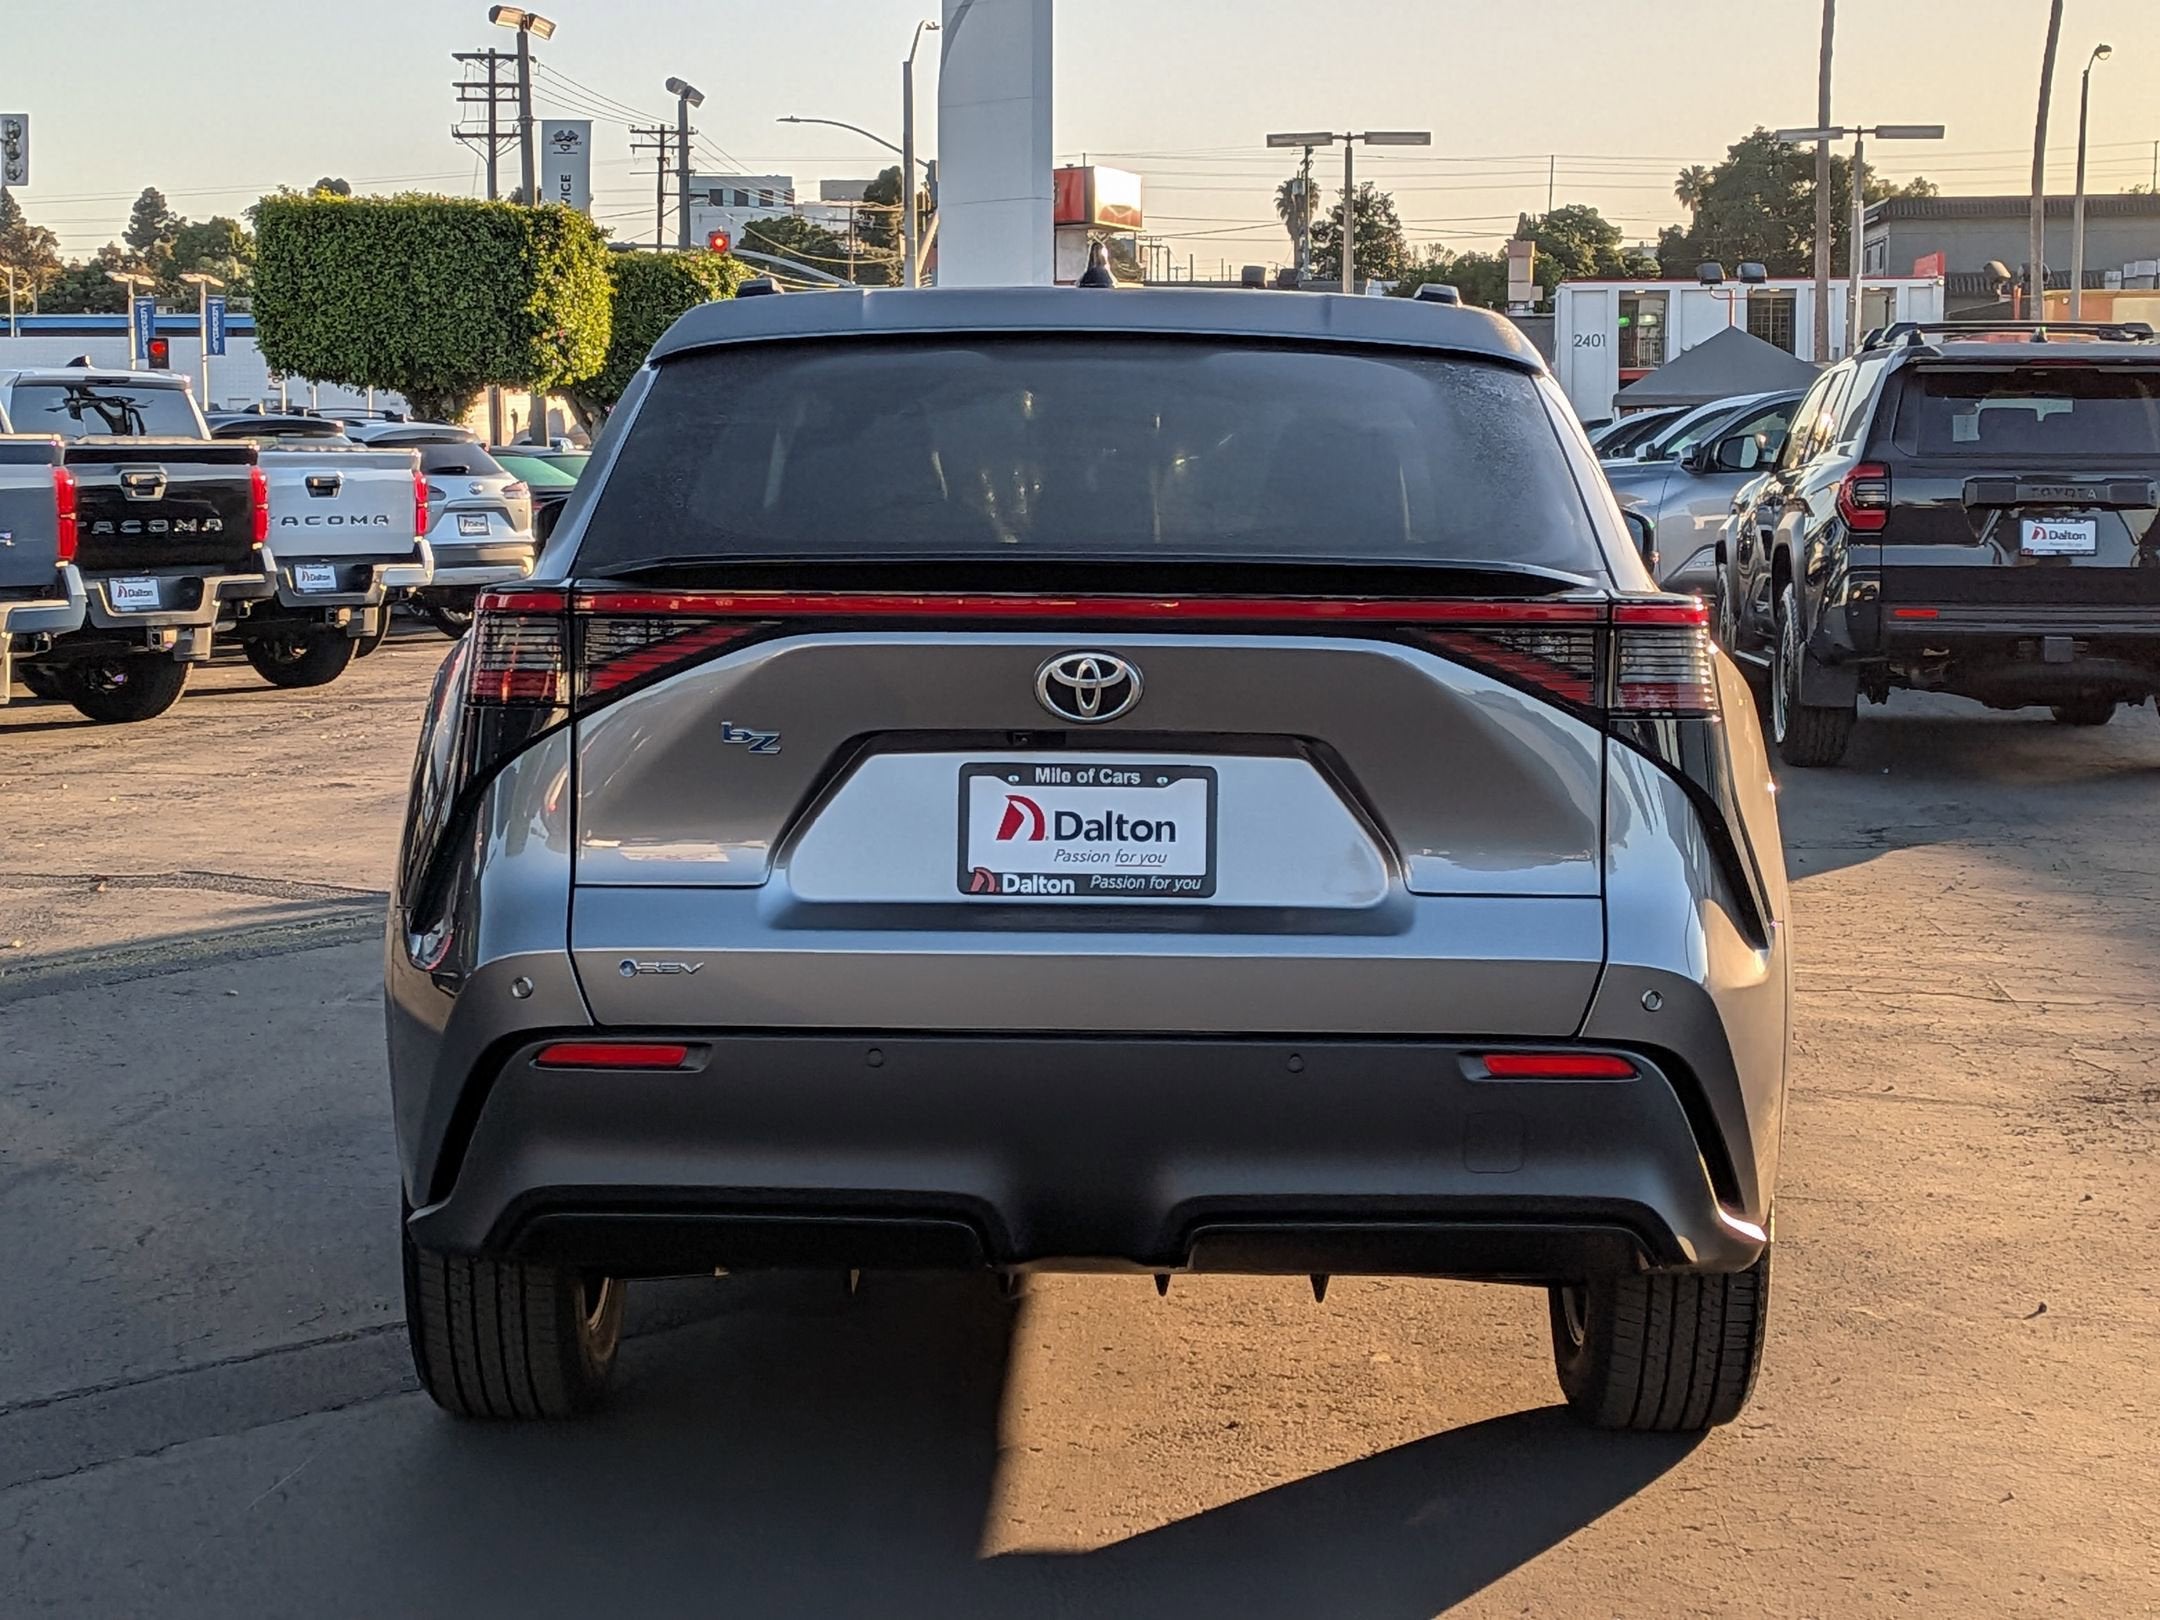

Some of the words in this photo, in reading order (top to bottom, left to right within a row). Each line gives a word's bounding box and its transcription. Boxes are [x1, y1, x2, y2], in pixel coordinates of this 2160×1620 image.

[1573, 333, 1606, 348] 2401
[2031, 487, 2097, 500] TOYOTA
[77, 518, 224, 534] ACOMA
[271, 514, 390, 527] ACOMA
[2049, 530, 2087, 541] Dalton
[1035, 767, 1071, 784] Mile
[1076, 767, 1096, 784] of
[1099, 768, 1141, 785] Cars
[1054, 810, 1176, 843] Dalton
[1053, 849, 1110, 863] Passion
[1114, 849, 1135, 865] for
[1138, 853, 1168, 866] you
[1002, 873, 1075, 894] Dalton
[1090, 874, 1145, 890] Passion
[1149, 875, 1170, 891] for
[1172, 877, 1202, 892] you
